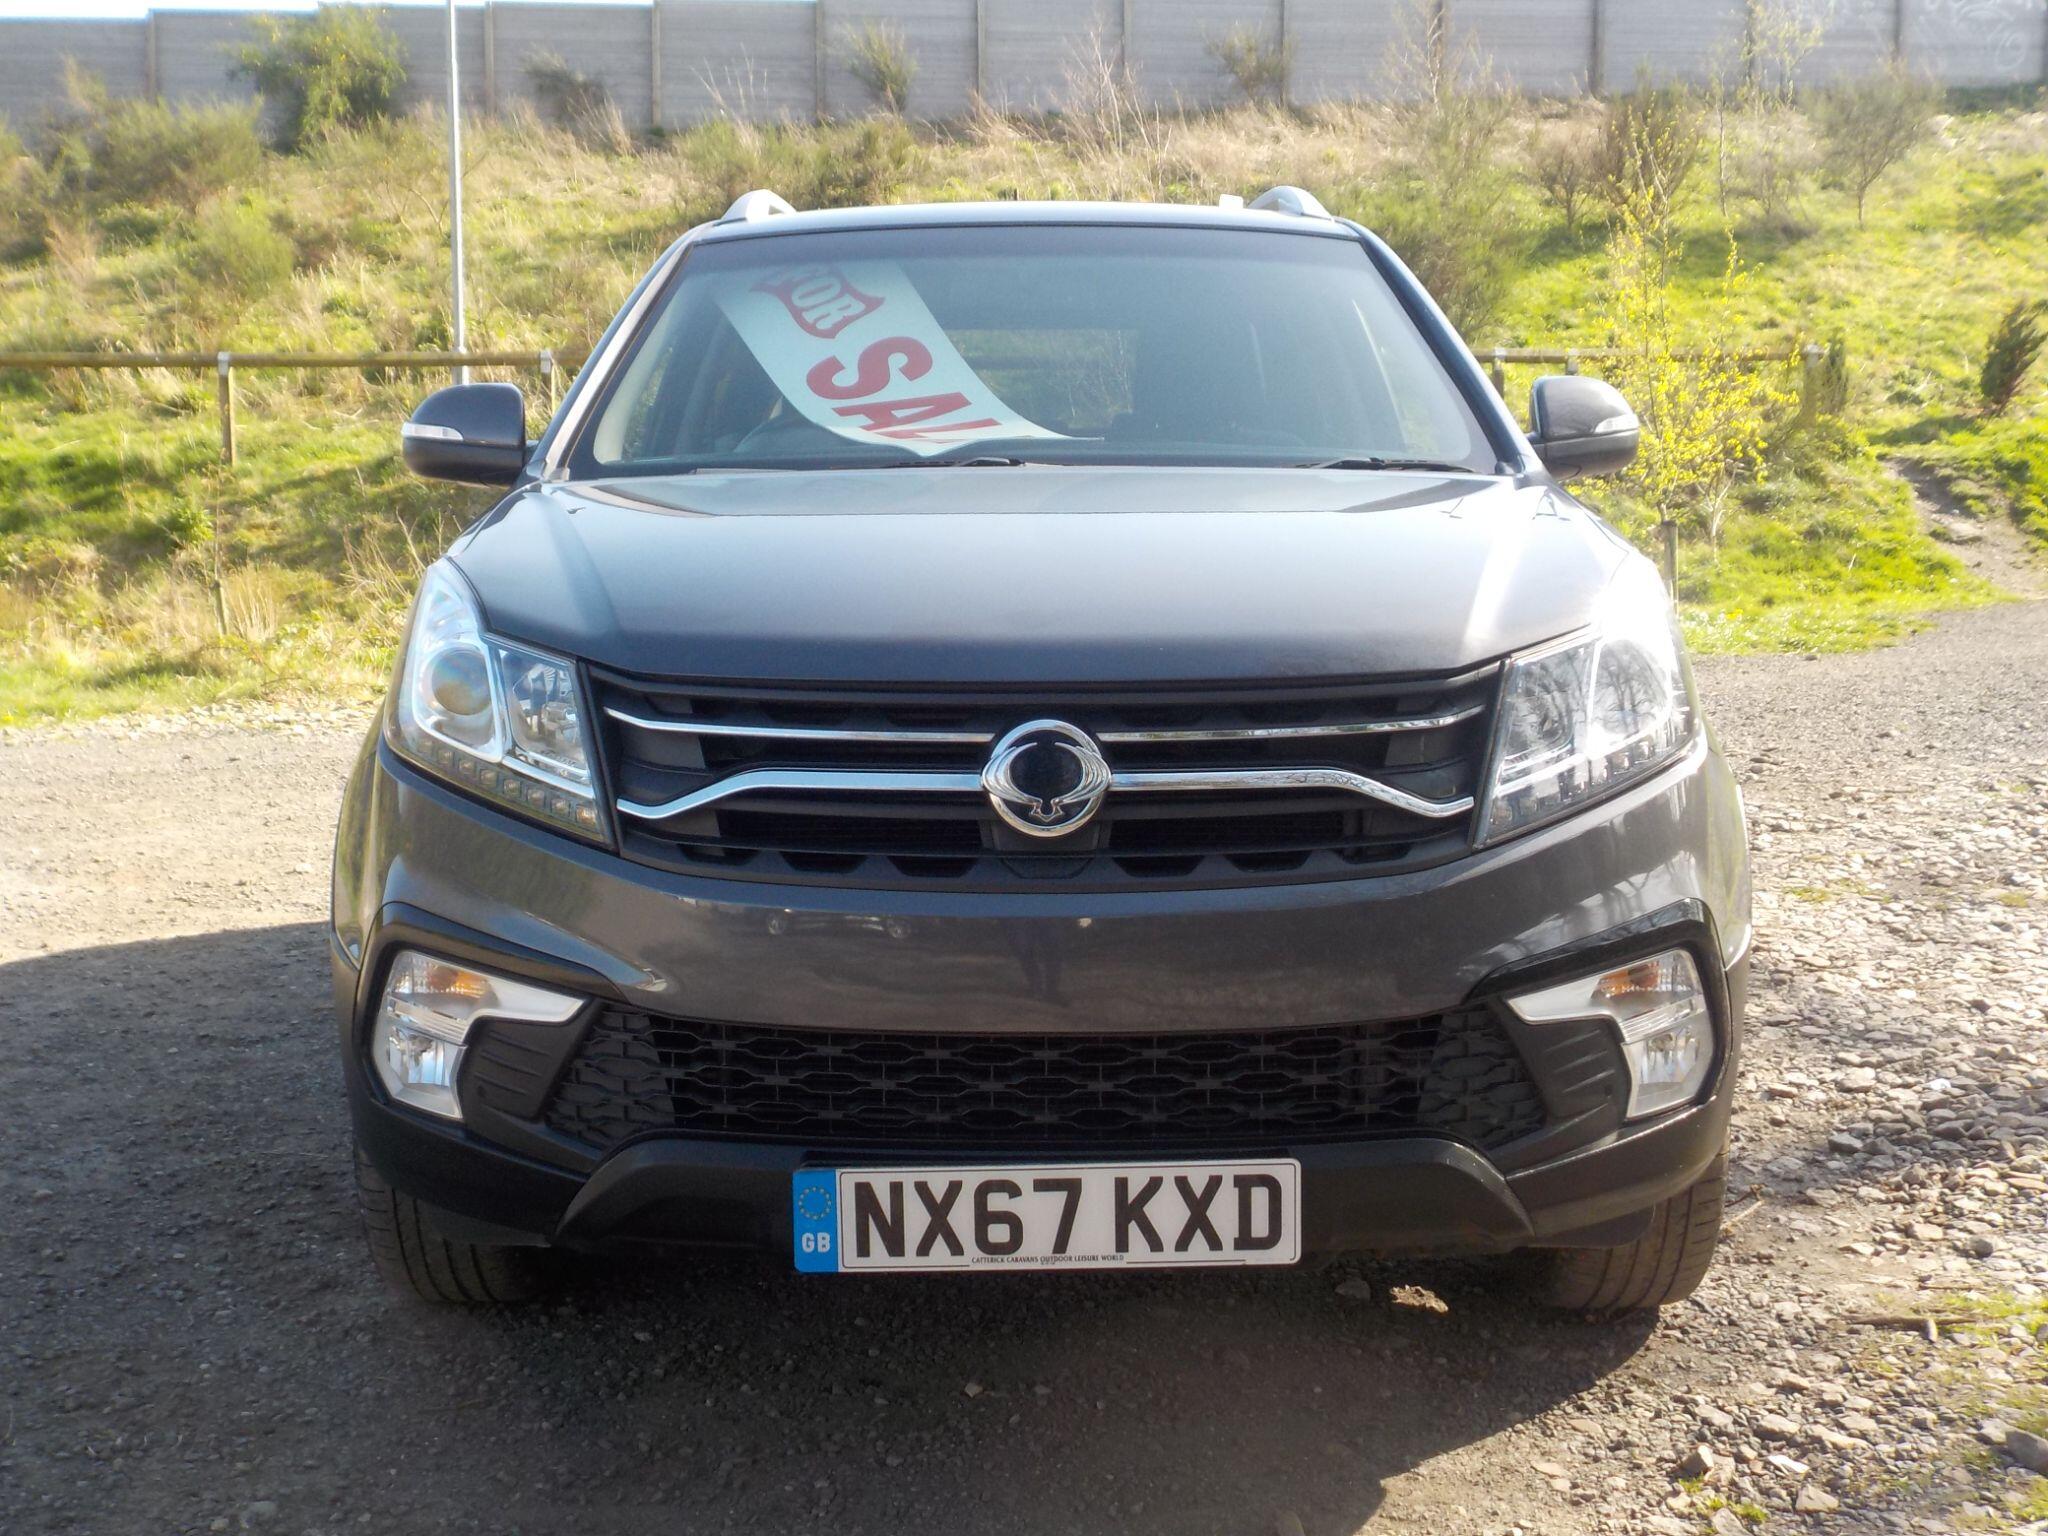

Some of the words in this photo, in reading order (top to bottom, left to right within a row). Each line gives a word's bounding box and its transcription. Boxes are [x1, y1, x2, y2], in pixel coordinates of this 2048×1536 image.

[806, 336, 1002, 444] SAL
[854, 1177, 1083, 1258] NX67
[1114, 1173, 1283, 1253] KXD
[801, 1232, 831, 1253] GB
[1040, 1255, 1073, 1263] OUTDOOR
[1074, 1254, 1099, 1262] LEISURE
[1101, 1254, 1124, 1262] WORLD
